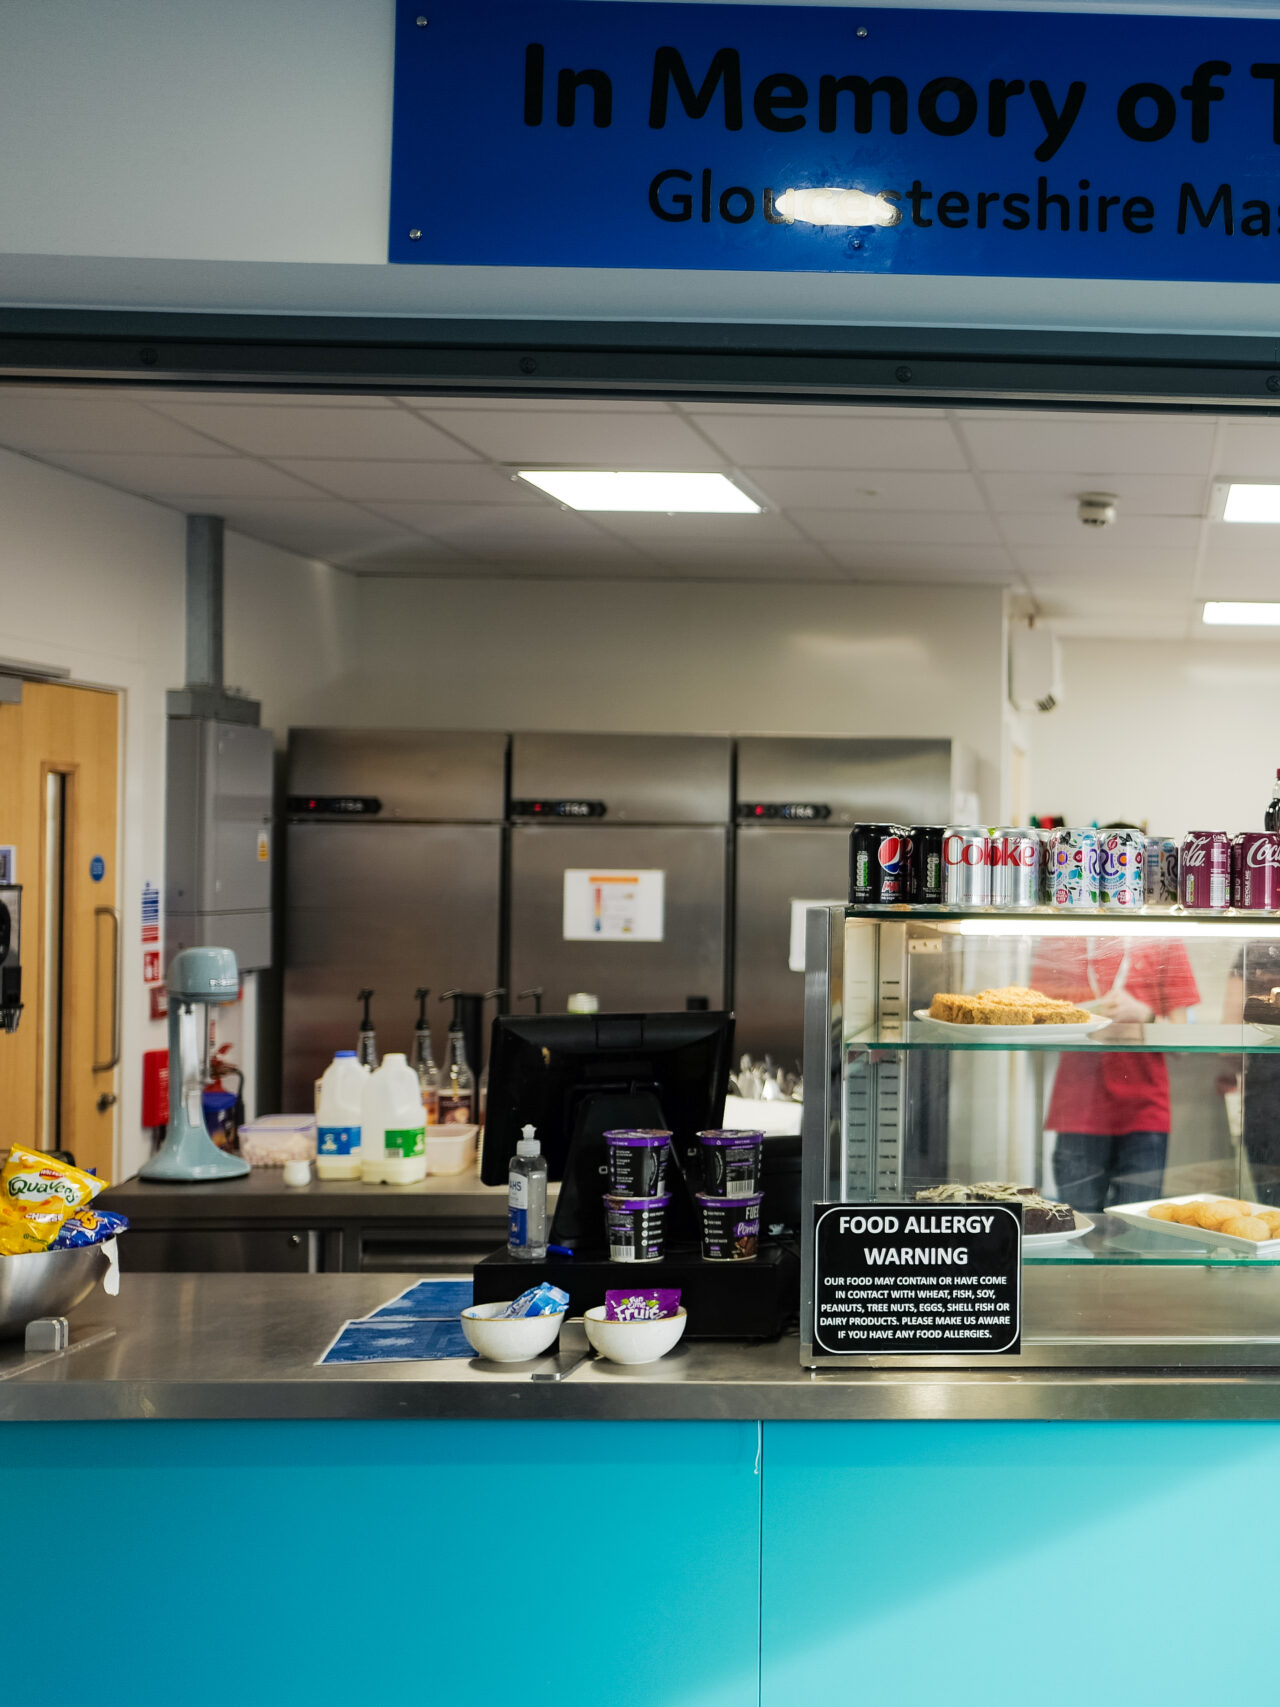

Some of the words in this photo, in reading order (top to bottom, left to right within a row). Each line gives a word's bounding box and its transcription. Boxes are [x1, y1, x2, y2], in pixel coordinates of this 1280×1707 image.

[523, 42, 612, 129] In
[649, 46, 1086, 162] Memory
[1117, 60, 1233, 143] of
[648, 167, 1155, 234] Gloustershire
[8, 1177, 76, 1203] Quavers
[840, 1217, 898, 1234] FOOD
[904, 1217, 994, 1234] ALLERGY
[864, 1248, 968, 1265] WARNING
[824, 1277, 844, 1285] OUR
[847, 1277, 872, 1285] FOOD
[875, 1277, 894, 1285] MAY
[897, 1277, 936, 1285] CONTAIN
[939, 1277, 952, 1285] OR
[954, 1277, 978, 1285] HAVE
[980, 1277, 1007, 1285] COME
[836, 1290, 845, 1299] IN
[848, 1290, 888, 1299] CONTACT
[891, 1290, 915, 1299] WITH
[917, 1290, 951, 1299] WHEAT,
[953, 1290, 974, 1299] FISH,
[977, 1290, 996, 1299] SOY,
[614, 1305, 667, 1321] Fruits
[821, 1303, 865, 1312] PEANUTS,
[867, 1303, 888, 1312] TREE
[891, 1303, 917, 1312] NUTS,
[919, 1303, 945, 1312] EGGS,
[947, 1303, 973, 1312] SHELL
[975, 1303, 994, 1312] FISH
[996, 1303, 1009, 1312] OR
[820, 1317, 847, 1325] DAIRY
[849, 1317, 899, 1325] PRODUCTS.
[902, 1317, 933, 1325] PLEASE
[935, 1317, 962, 1325] MAKE
[964, 1317, 976, 1325] US
[978, 1317, 1010, 1325] AWARE
[838, 1330, 845, 1339] IF
[848, 1330, 867, 1339] YOU
[869, 1330, 893, 1339] HAVE
[895, 1330, 914, 1339] ANY
[916, 1330, 941, 1339] FOOD
[944, 1330, 992, 1339] ALLERGIES.
